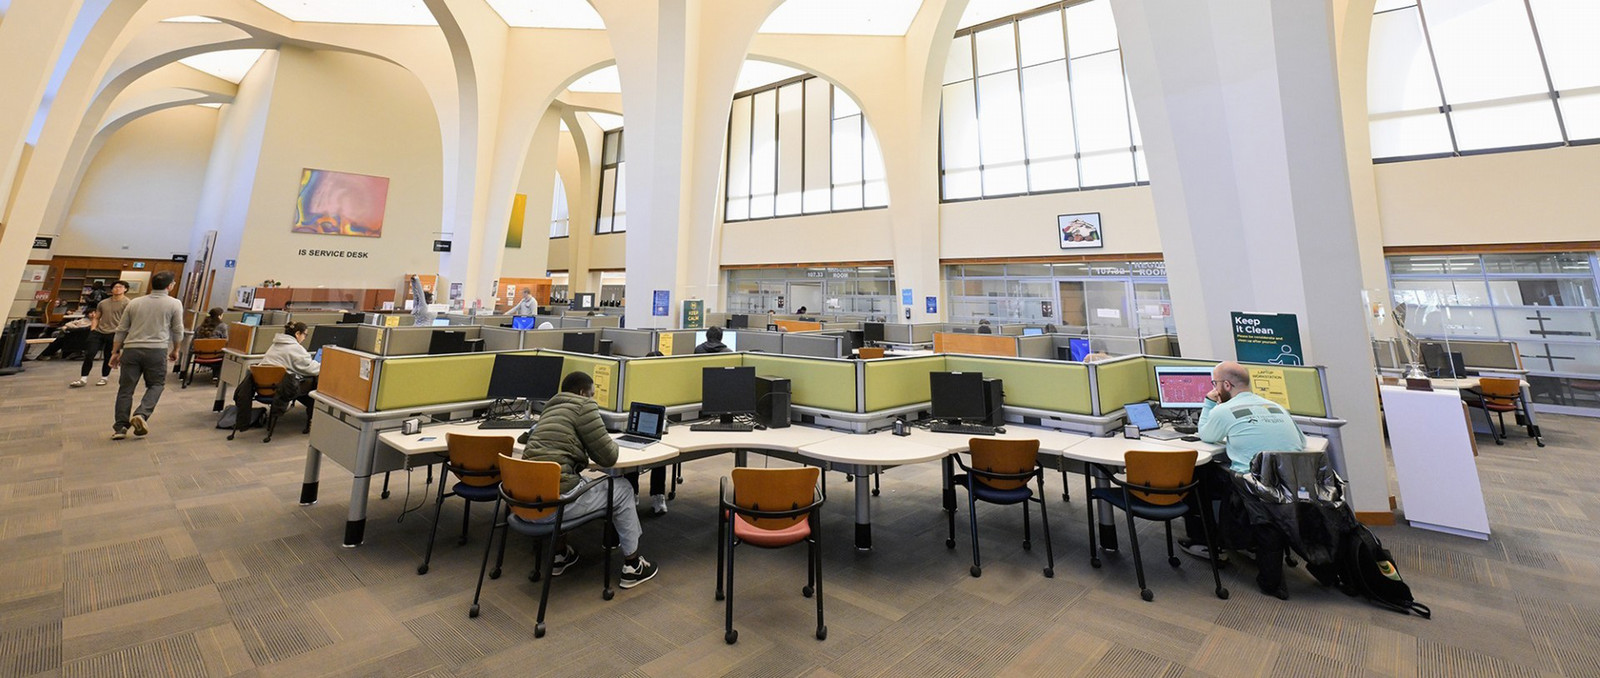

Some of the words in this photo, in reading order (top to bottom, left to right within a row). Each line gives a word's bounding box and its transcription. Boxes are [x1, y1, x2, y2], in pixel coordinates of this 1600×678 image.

[308, 250, 345, 258] SERVICE
[1234, 316, 1260, 326] Keep
[1245, 326, 1274, 334] Clean
